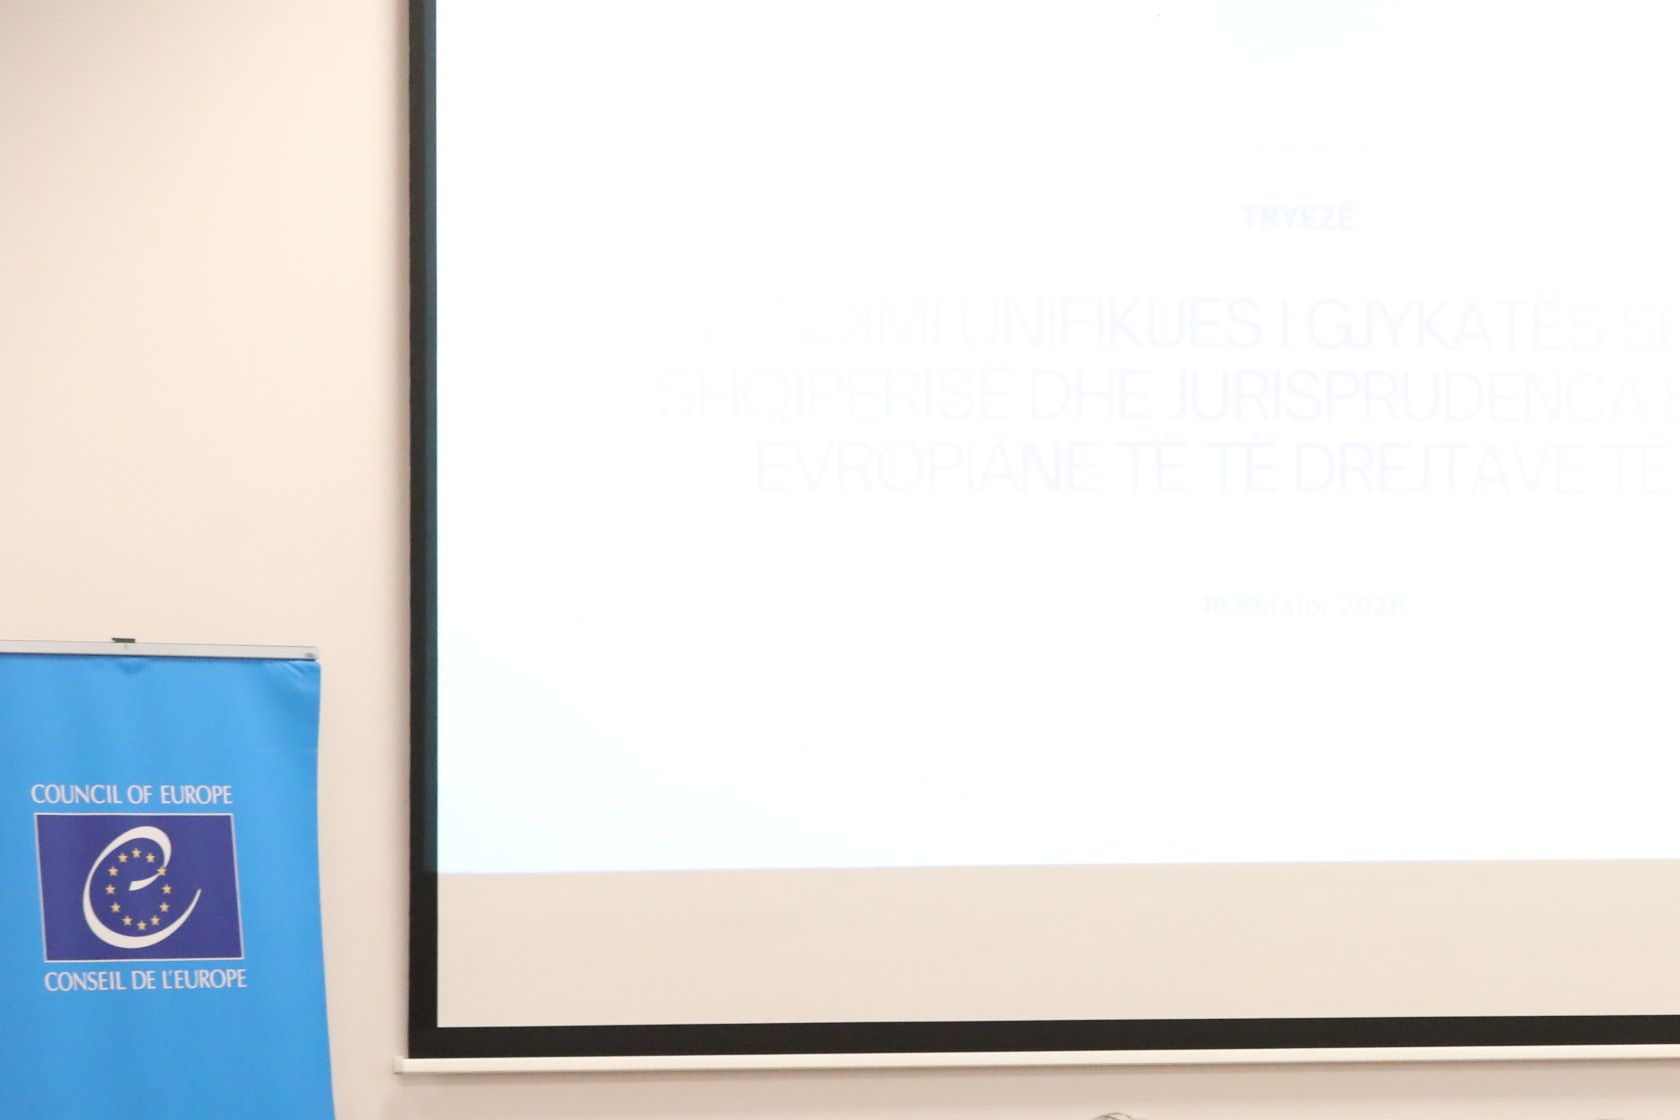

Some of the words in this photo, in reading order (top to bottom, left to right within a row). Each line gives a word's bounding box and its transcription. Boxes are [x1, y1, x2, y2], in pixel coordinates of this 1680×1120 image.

[961, 295, 1263, 351] UNIFIKUES
[1029, 367, 1153, 420] DHE
[1166, 368, 1649, 423] JURISPRUDENCA
[754, 440, 1102, 494] EVROPIANE
[1296, 442, 1586, 495] DREJTAVE
[31, 784, 123, 804] COUNCIL
[127, 785, 152, 804] OF
[160, 784, 234, 805] EUROPE
[44, 971, 127, 991] CONSEIL
[132, 970, 155, 990] DE
[162, 968, 248, 990] L'EUROPE
